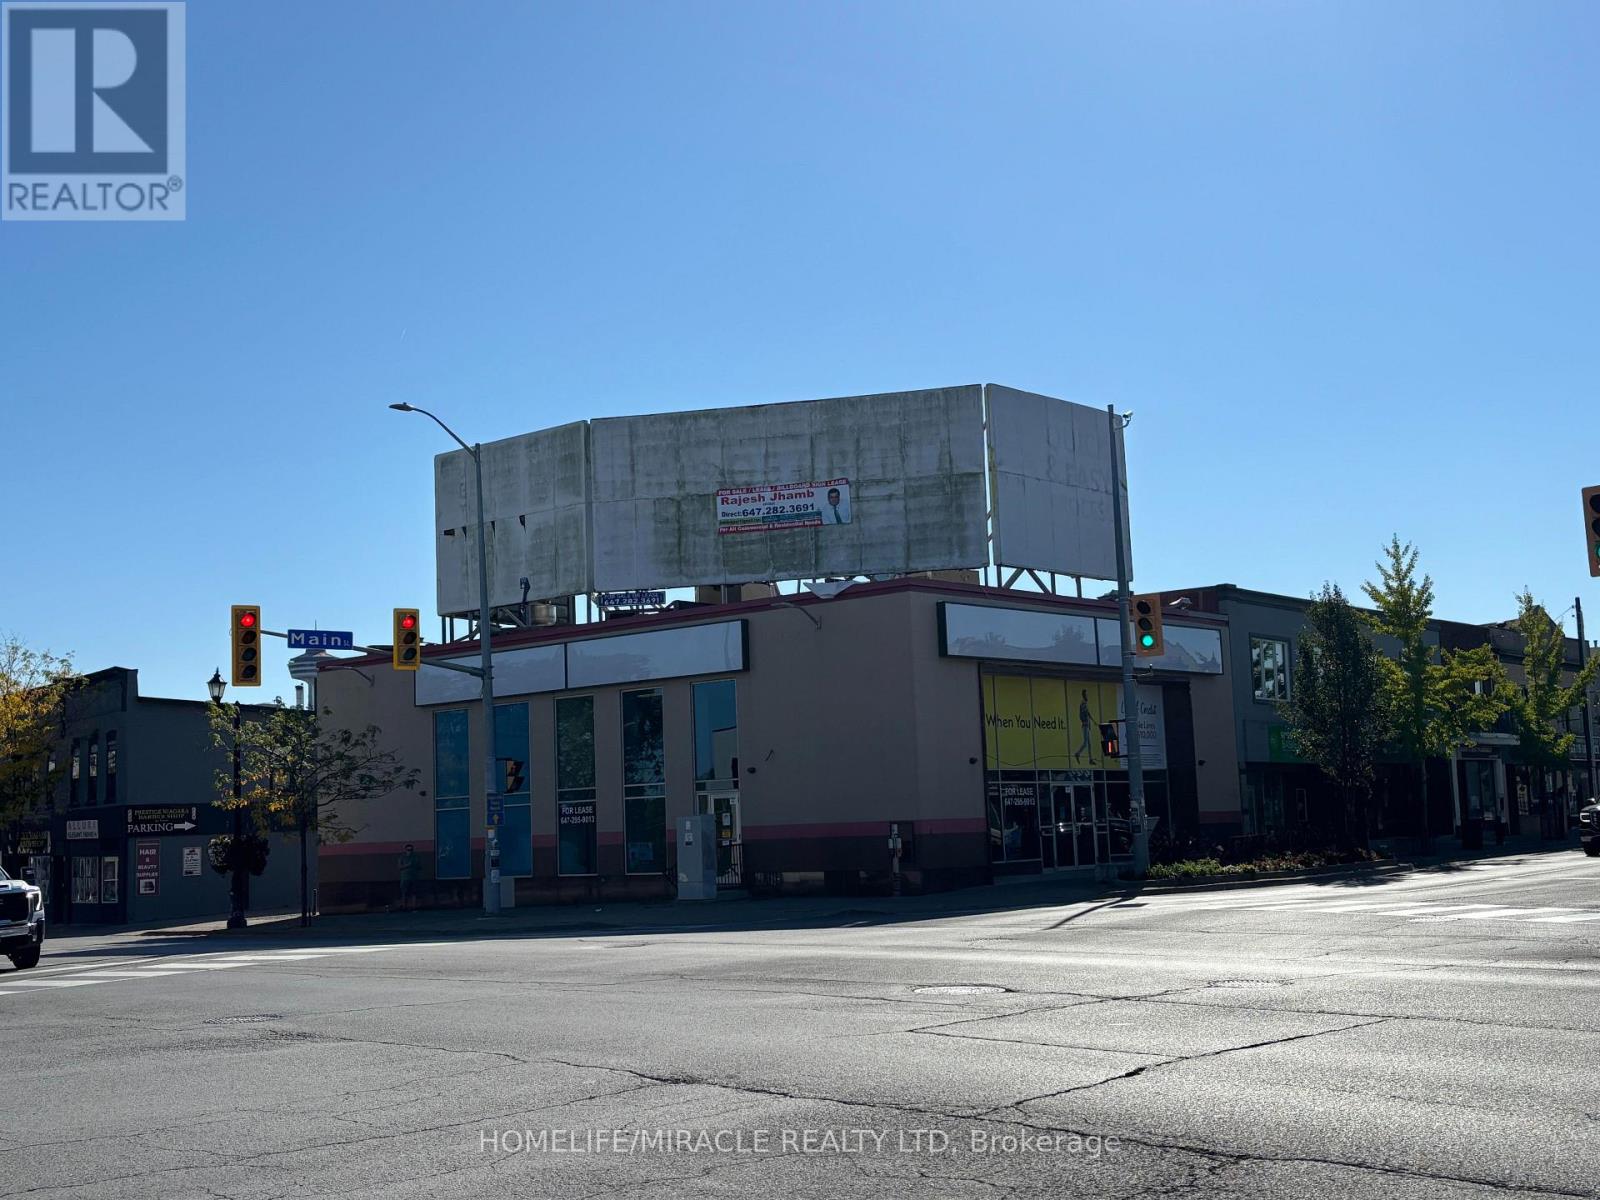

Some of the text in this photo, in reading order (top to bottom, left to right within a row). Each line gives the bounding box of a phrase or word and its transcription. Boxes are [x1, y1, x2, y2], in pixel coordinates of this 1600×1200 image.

[720, 494, 766, 506] Rajesh
[770, 489, 815, 501] Jhamb
[742, 503, 815, 517] 647.282.3691
[290, 632, 342, 646] Main
[985, 713, 1067, 730] When You Need It.
[1005, 787, 1016, 796] FOR
[1017, 786, 1034, 796] LEASE
[561, 805, 593, 815] FOR LEASE
[127, 822, 174, 833] PARKING
[139, 848, 157, 856] HAIR
